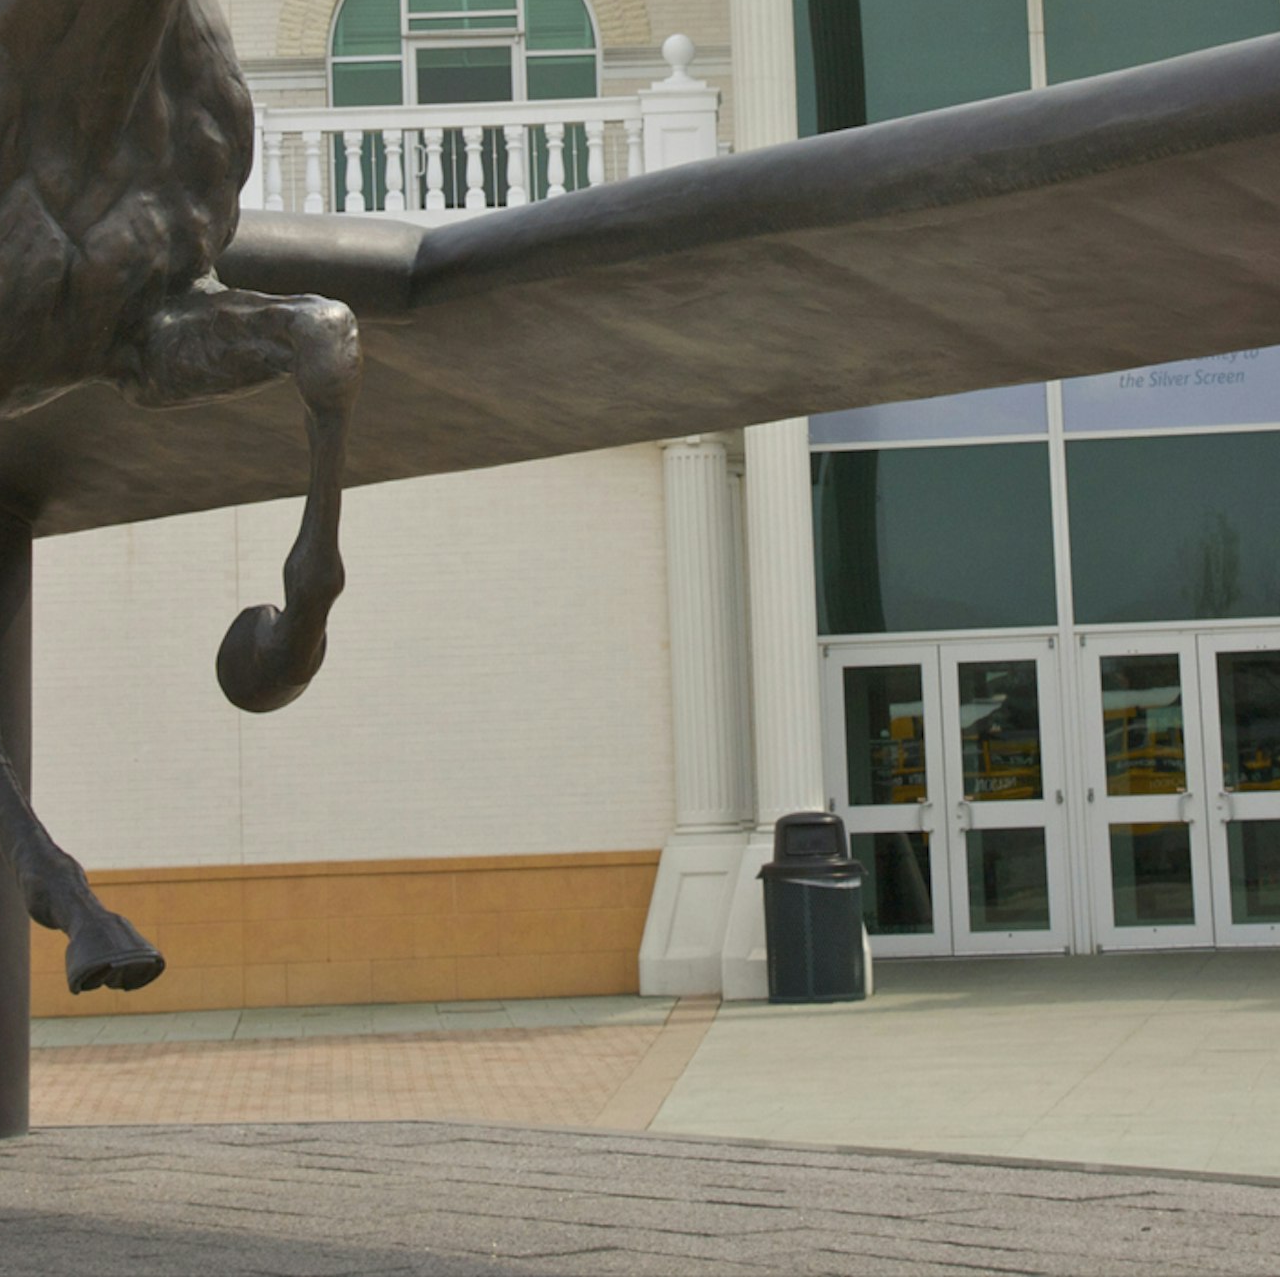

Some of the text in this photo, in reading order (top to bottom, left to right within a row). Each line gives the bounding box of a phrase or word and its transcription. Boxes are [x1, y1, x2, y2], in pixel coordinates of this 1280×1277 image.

[1120, 369, 1245, 388] the Silver Screen
